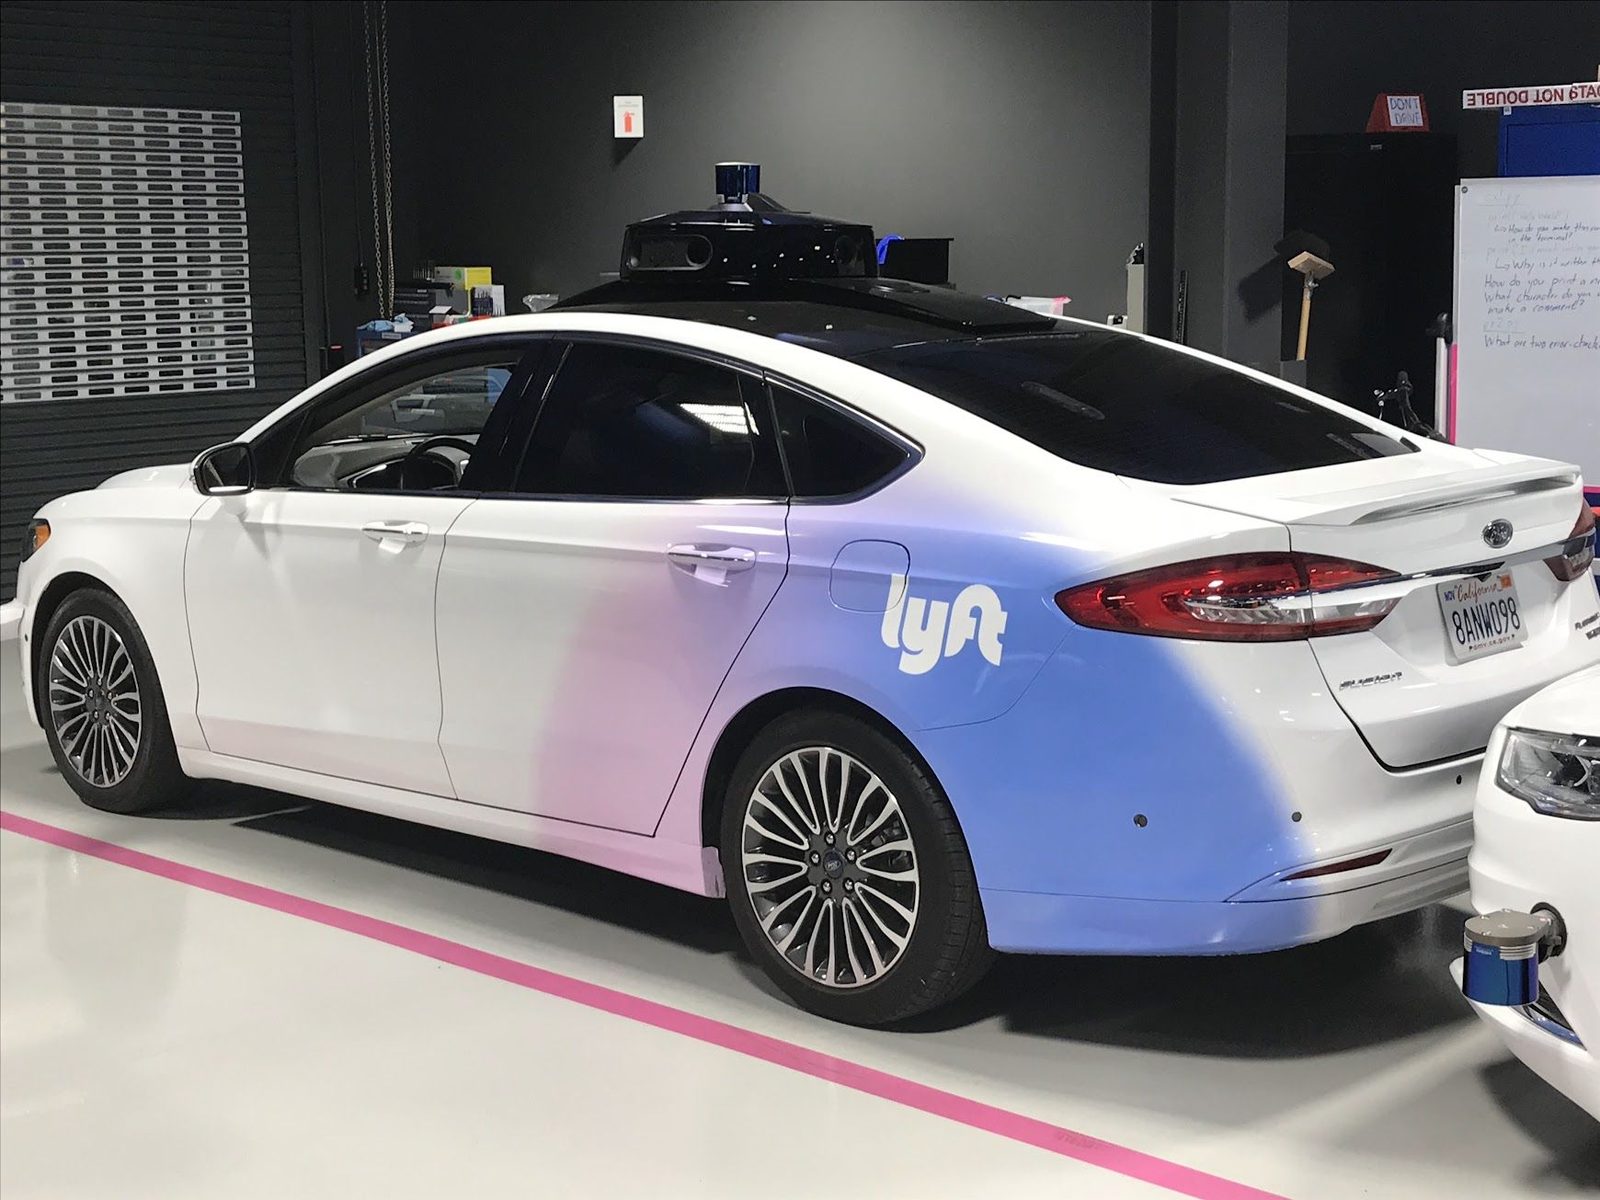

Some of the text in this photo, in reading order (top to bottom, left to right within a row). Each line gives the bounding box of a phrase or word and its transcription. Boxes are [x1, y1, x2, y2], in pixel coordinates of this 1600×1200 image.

[1467, 88, 1564, 106] NOT DOUBLE
[1513, 259, 1534, 273] Why
[1485, 274, 1505, 287] How
[1509, 273, 1520, 286] do
[1528, 279, 1544, 293] you
[1485, 289, 1511, 302] What
[1562, 288, 1573, 299] do
[1577, 292, 1591, 302] you
[1488, 303, 1514, 315] make
[1485, 334, 1511, 347] What
[1514, 340, 1527, 348] are
[1530, 335, 1547, 348] two
[1457, 581, 1497, 603] California
[881, 573, 1008, 675] lyft
[1452, 597, 1520, 645] 8ANW098
